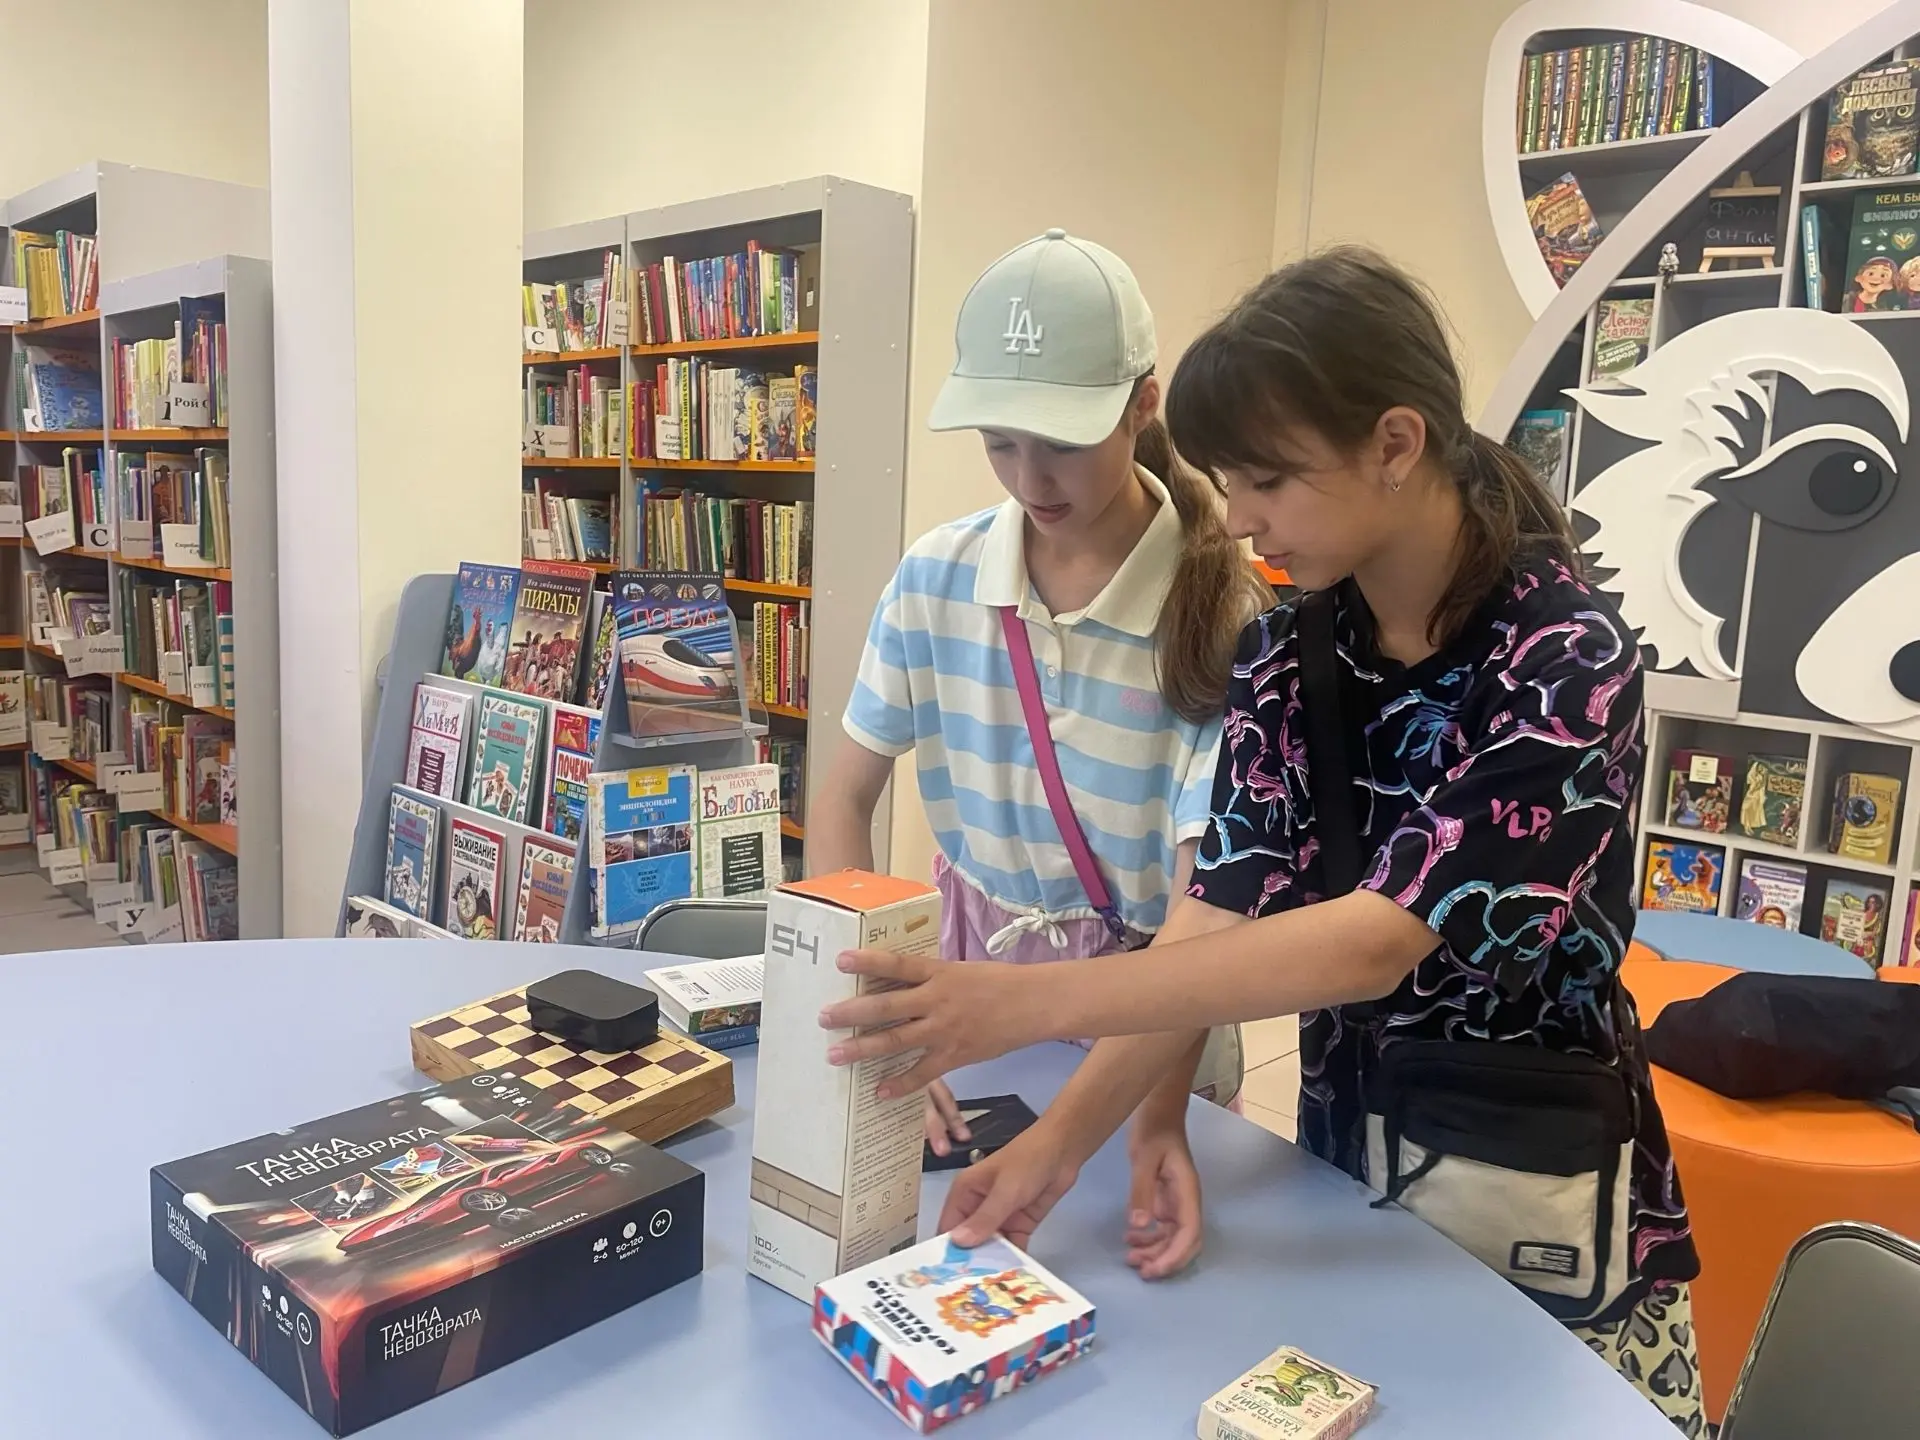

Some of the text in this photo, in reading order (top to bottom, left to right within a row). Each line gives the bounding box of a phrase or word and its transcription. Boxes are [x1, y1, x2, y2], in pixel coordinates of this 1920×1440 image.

[1876, 193, 1900, 204] КЕМ
[1003, 297, 1043, 355] LA
[1603, 311, 1649, 329] Лесная
[174, 397, 199, 409] Рой
[90, 529, 109, 546] С
[520, 588, 582, 616] ПИРАТЫ
[633, 607, 718, 628] ПОЕЗДА
[729, 779, 757, 789] НАУКУ
[619, 797, 677, 812] ЭНЦИКЛОПЕДИЯ
[454, 834, 496, 861] ВЫЖИВАНИЕ
[125, 908, 145, 927] У
[771, 923, 819, 965] 54
[868, 925, 888, 943] 54
[235, 1137, 360, 1177] ТАЧКА
[258, 1126, 439, 1187] НЕВОЗВРАТА
[165, 1201, 191, 1232] ТАЧКА
[499, 1211, 589, 1249] НАСТОЛЬНАЯ ИГРА
[167, 1220, 208, 1264] НЕВОЗВРАТА
[615, 1235, 644, 1254] 50-120
[754, 1235, 780, 1256] 100%
[379, 1306, 442, 1344] ТАЧКА
[866, 1280, 957, 1355] КОРОЛЕВСТВО
[383, 1307, 482, 1360] НЕВОЗВРАТА
[1231, 1393, 1302, 1433] КАРТОДИЛ
[1305, 1407, 1323, 1419] 54
